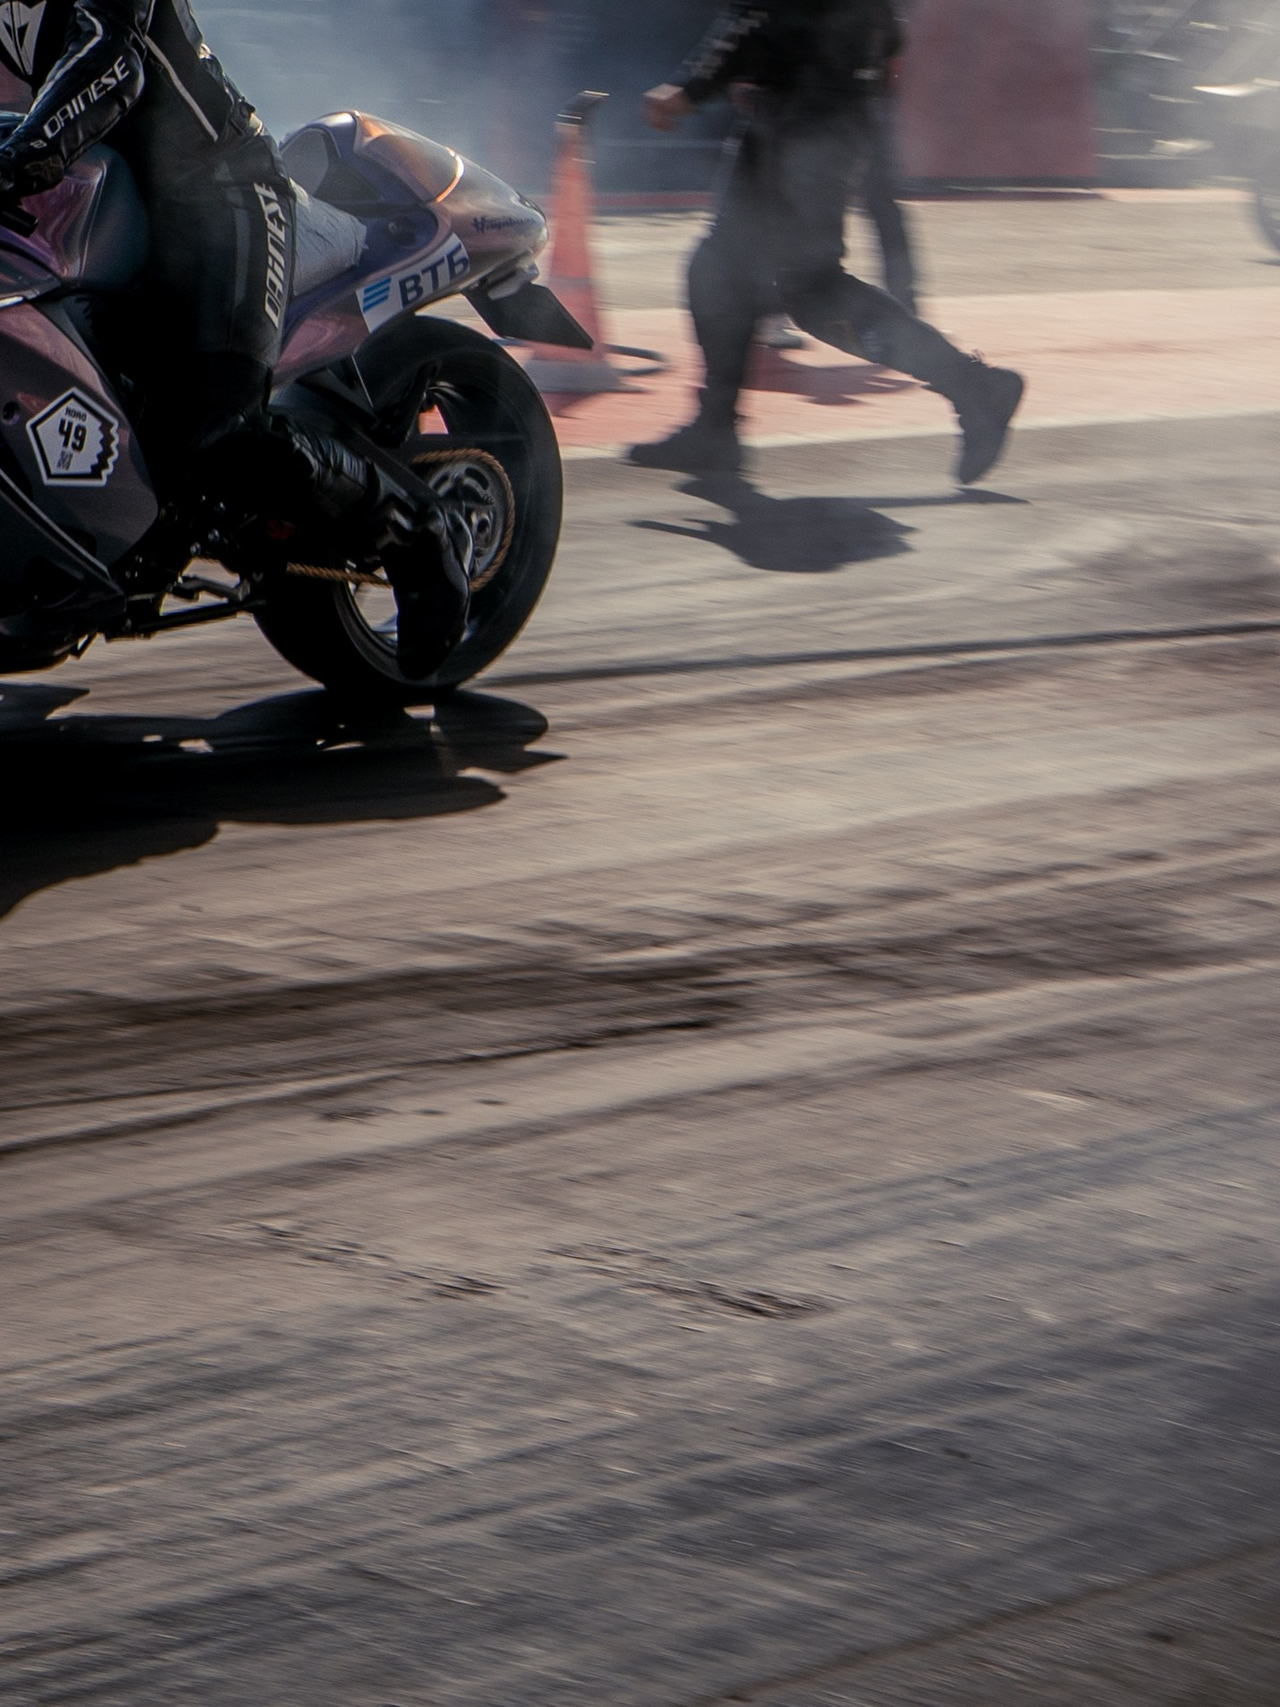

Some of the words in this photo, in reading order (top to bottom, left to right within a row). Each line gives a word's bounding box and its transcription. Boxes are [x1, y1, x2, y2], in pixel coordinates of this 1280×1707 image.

[42, 55, 130, 139] DAINESE
[253, 182, 286, 329] DAINESE
[399, 243, 469, 309] ВТБ
[59, 418, 87, 453] 49
